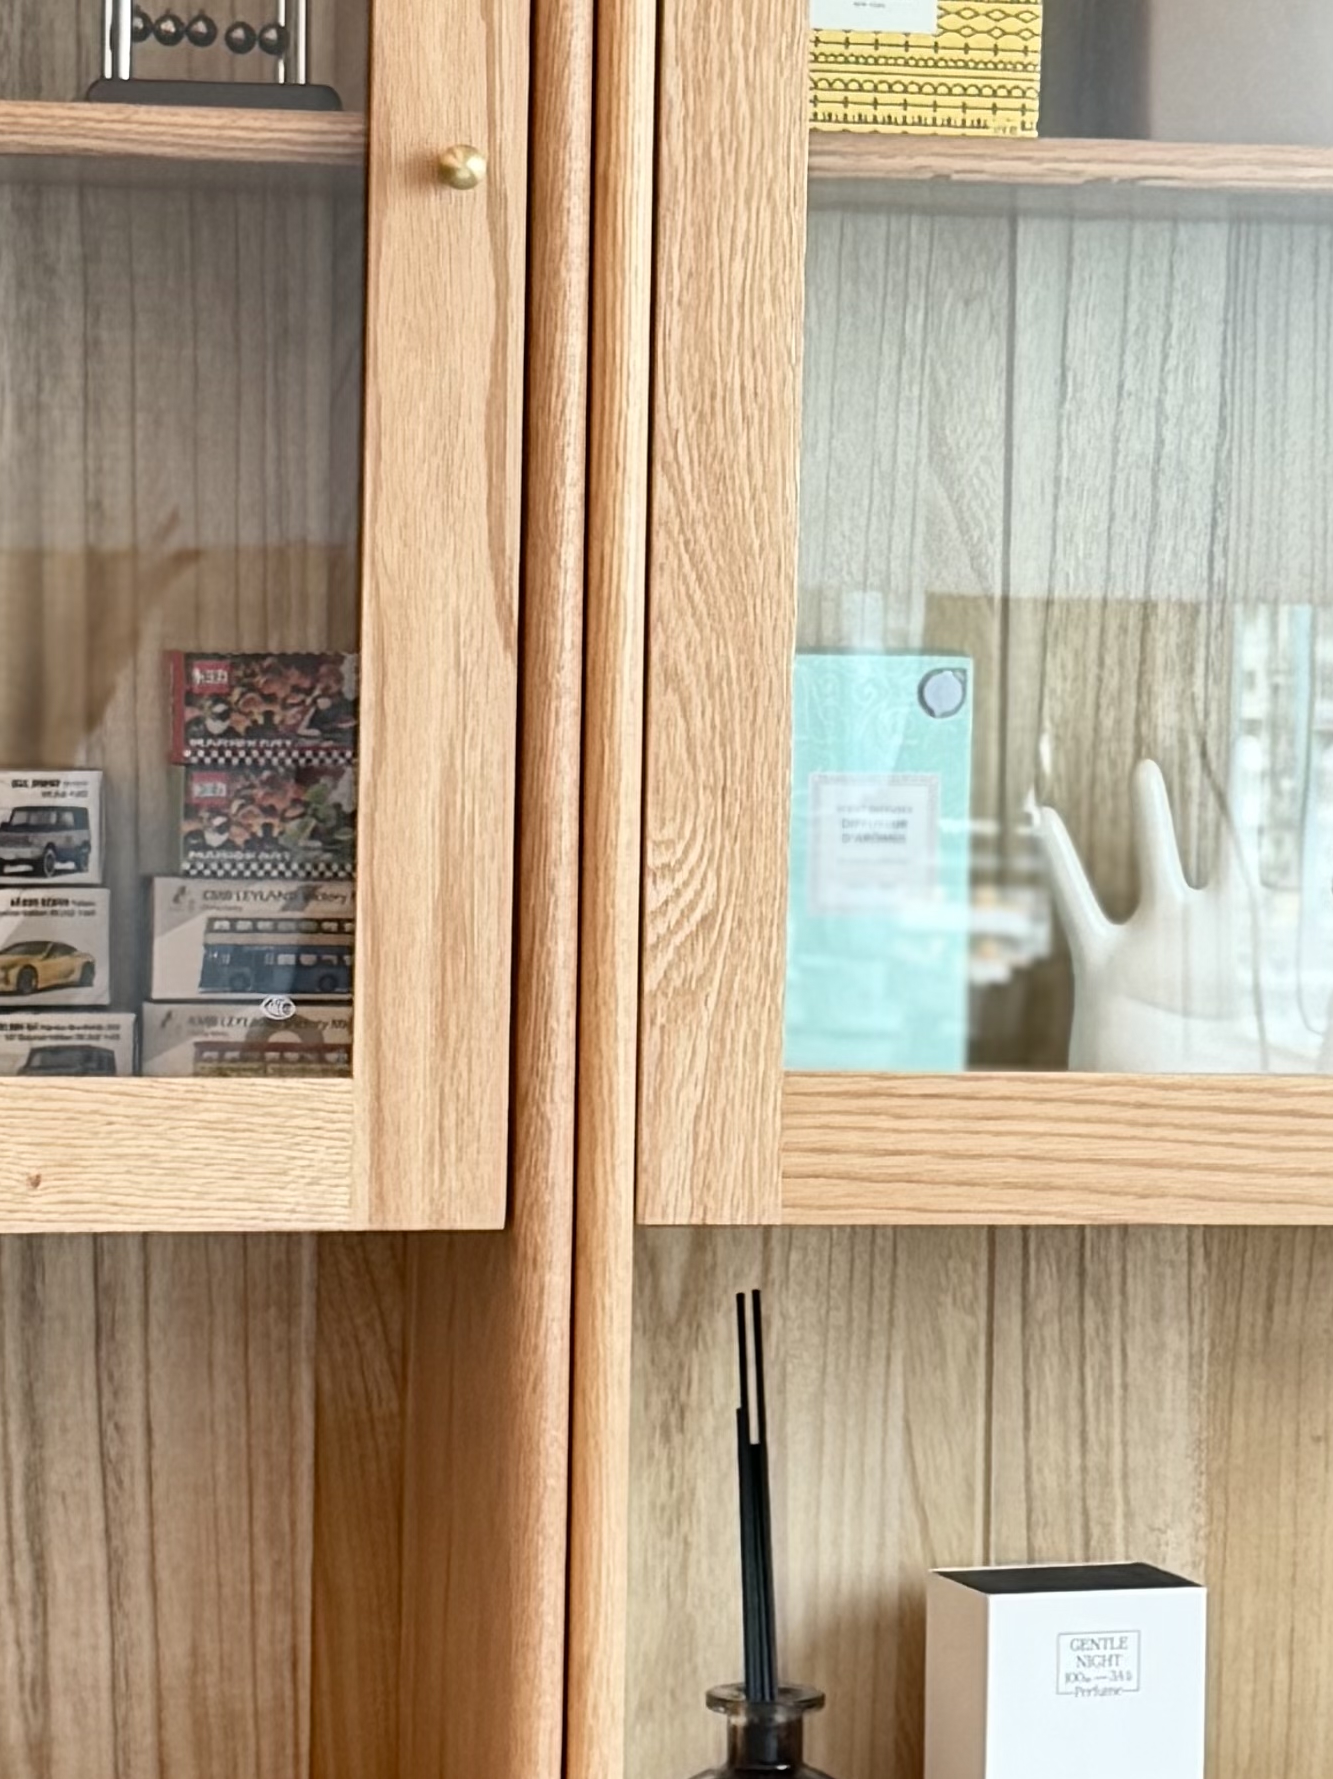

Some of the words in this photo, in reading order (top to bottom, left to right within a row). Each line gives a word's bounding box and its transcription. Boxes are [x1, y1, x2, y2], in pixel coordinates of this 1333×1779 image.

[236, 890, 295, 903] LEYLAND
[1070, 1636, 1128, 1651] GENTLE
[1077, 1653, 1123, 1668] NIGHT
